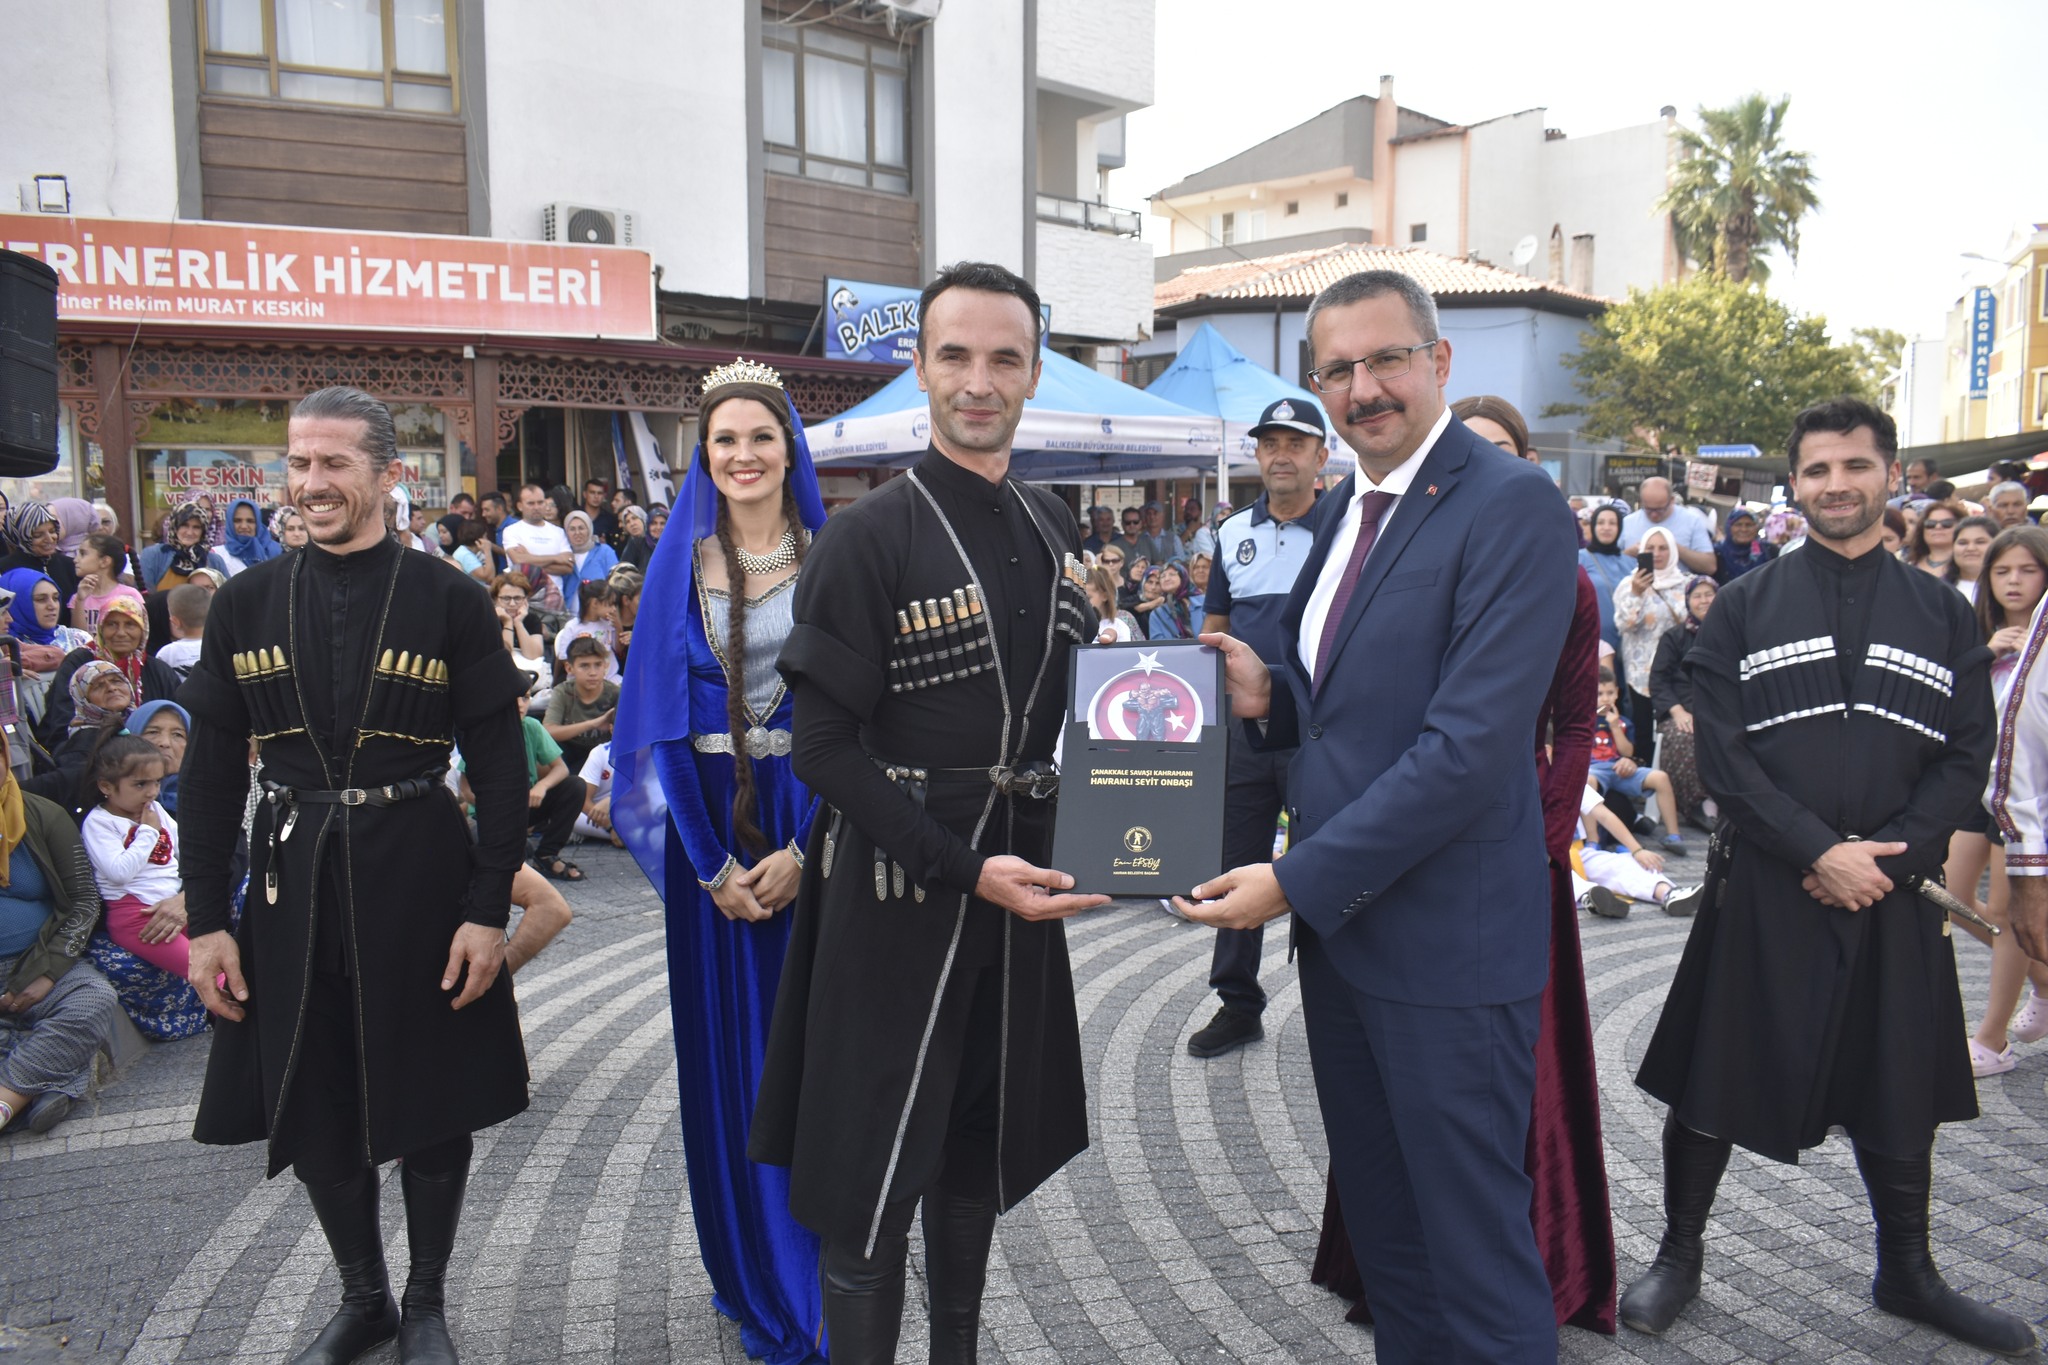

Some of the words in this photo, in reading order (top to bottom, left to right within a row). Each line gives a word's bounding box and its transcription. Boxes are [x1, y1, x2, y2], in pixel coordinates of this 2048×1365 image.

[0, 233, 300, 293] RİNERLİK
[313, 246, 601, 306] HİZMETLERİ
[109, 295, 172, 313] Hekim
[177, 297, 248, 315] MURAT
[253, 297, 325, 318] KESKİN
[1977, 289, 1991, 343] DEKOR
[838, 299, 921, 353] BALIK
[821, 444, 854, 458] BÜYÜKŞEHİR
[856, 440, 889, 453] BELEDİYESİ
[1045, 439, 1082, 450] BALIKESİR
[1083, 440, 1125, 452] BÜYÜKŞEHİR
[1126, 443, 1163, 453] BELEDİYESİ
[169, 463, 265, 487] KESKİN
[1090, 777, 1133, 786] HAVRANLI
[1135, 777, 1159, 786] SEYİT
[1160, 778, 1193, 788] ONBAŞI
[1091, 768, 1129, 777] ÇANAKKALE
[1130, 769, 1152, 777] SAVAŞI
